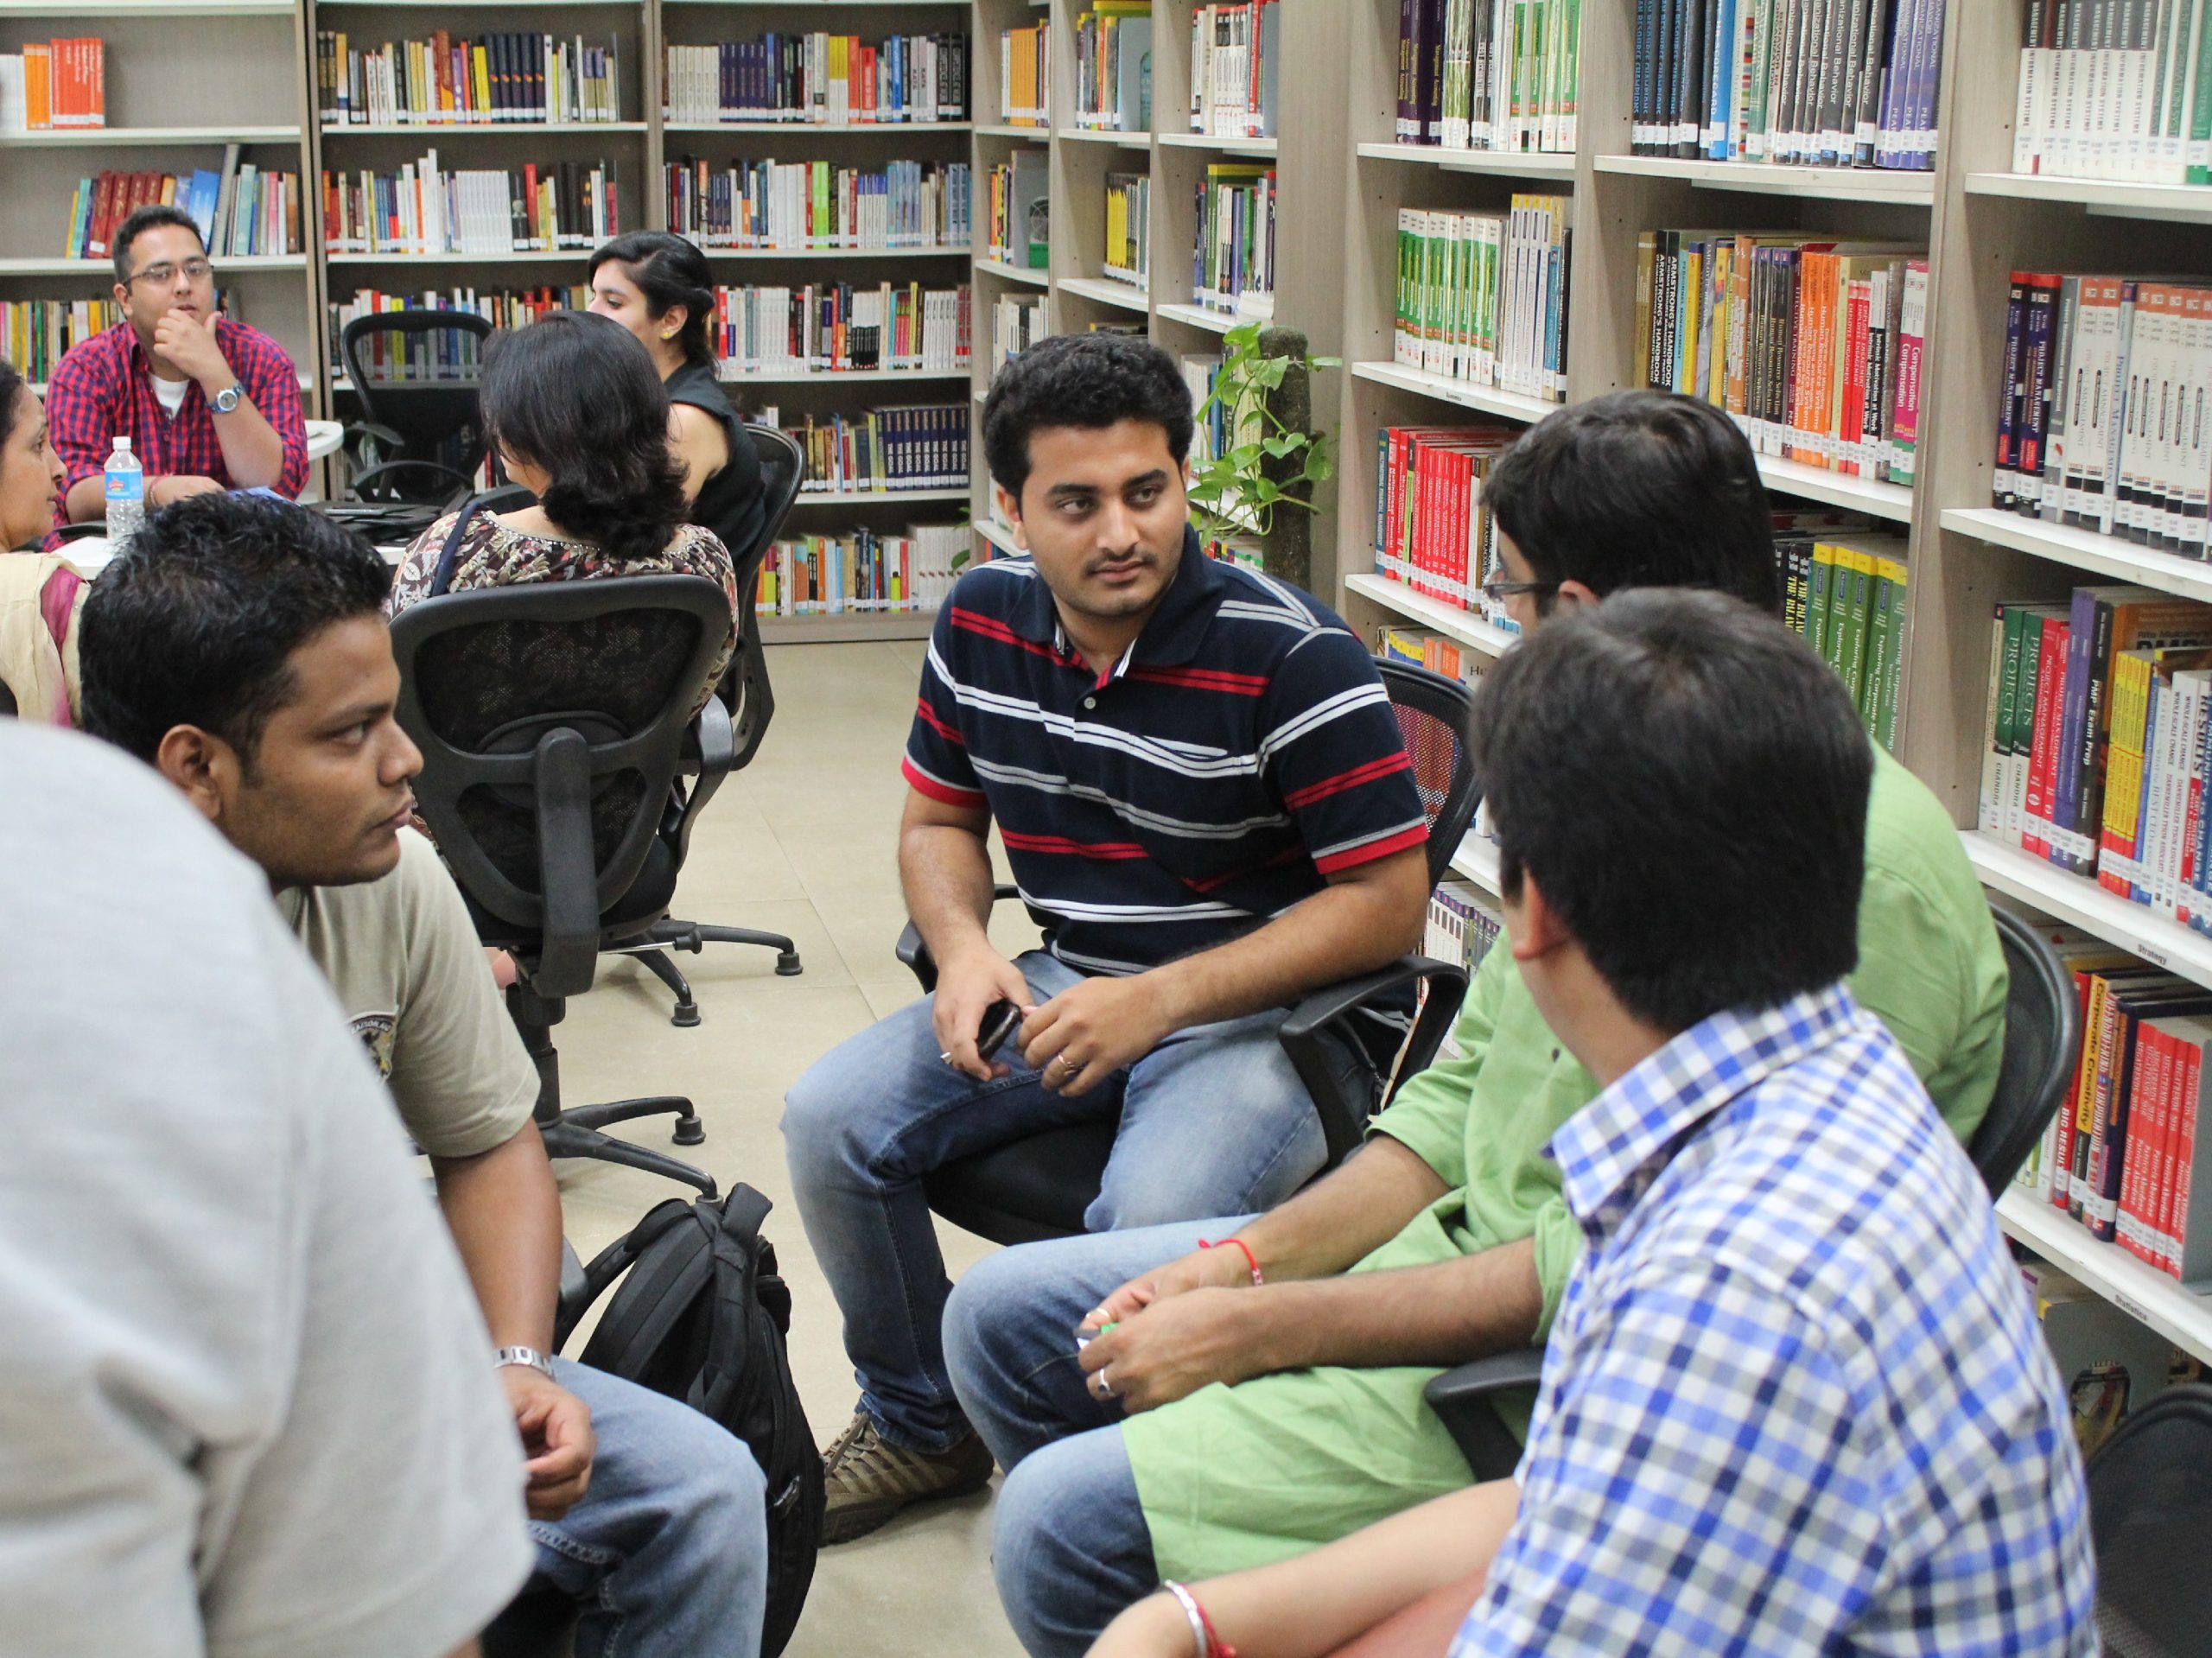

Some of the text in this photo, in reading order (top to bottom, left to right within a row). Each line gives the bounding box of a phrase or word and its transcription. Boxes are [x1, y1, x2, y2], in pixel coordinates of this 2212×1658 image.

[1774, 12, 1783, 86] BEHAVIOR IN
[2025, 50, 2035, 94] INFORMATION
[1564, 54, 1573, 92] Accounting
[1711, 41, 1719, 115] SCORECARD
[1830, 58, 1840, 105] Behavior
[2051, 52, 2062, 96] INFORMATION
[2067, 51, 2076, 96] INFORMATION
[2086, 54, 2095, 98] INFORMATION
[2023, 97, 2031, 127] SYSTEMS
[2049, 99, 2057, 129] SYSTEMS
[2064, 99, 2073, 130] SYSTEMS
[2083, 101, 2092, 131] SYSTEMS
[1653, 254, 1665, 384] ARMSTRONG'S HANDBOOK
[1665, 257, 1677, 387] ARMSTRONG'S HANDBOOK
[1805, 307, 1815, 341] Human
[1789, 334, 1798, 377] TRAINING
[1803, 343, 1812, 388] Resource
[1812, 305, 1827, 430] Human Resource Systems
[1897, 343, 1910, 408] Compensation
[1872, 363, 1880, 401] Motivation
[1907, 346, 1921, 412] Compensation
[2004, 336, 2018, 427] PROJECT MANAGEMENT
[2031, 340, 2047, 433] PROJECT MANAGEMENT
[1870, 412, 1878, 432] Work
[1834, 622, 1845, 662] Exploring
[1870, 635, 1886, 721] Exploring Corporate
[1890, 668, 1902, 714] Corporate
[2002, 636, 2020, 726] PROJECTS
[2023, 636, 2039, 726] PROJECTS
[1886, 715, 1898, 752] Strategy
[2036, 655, 2053, 769] PROJECT MANAGEMENT
[2050, 671, 2066, 779] PROJECT MANAGEMENT
[2086, 709, 2096, 738] Exam
[2167, 691, 2180, 766] WHOLE-SCALE CHANGE
[2177, 696, 2192, 771] WHOLE-SCALE CHANGE
[2082, 741, 2093, 765] Prep
[2143, 725, 2154, 775] Capabilities
[1992, 762, 2003, 807] CHANDRA
[2012, 764, 2022, 808] CHANDRA
[2138, 943, 2167, 965] Strategy
[2079, 982, 2105, 1127] Corporate Creativity
[2158, 1055, 2171, 1107] MEGATRENDS
[2171, 1059, 2183, 1112] MEGATRENDS
[2124, 1134, 2134, 1166] Patricia
[2146, 1150, 2162, 1217] Patricia Aburdene
[2158, 1155, 2174, 1223] Patricia Aburdene
[2114, 1295, 2148, 1322] Statistics
